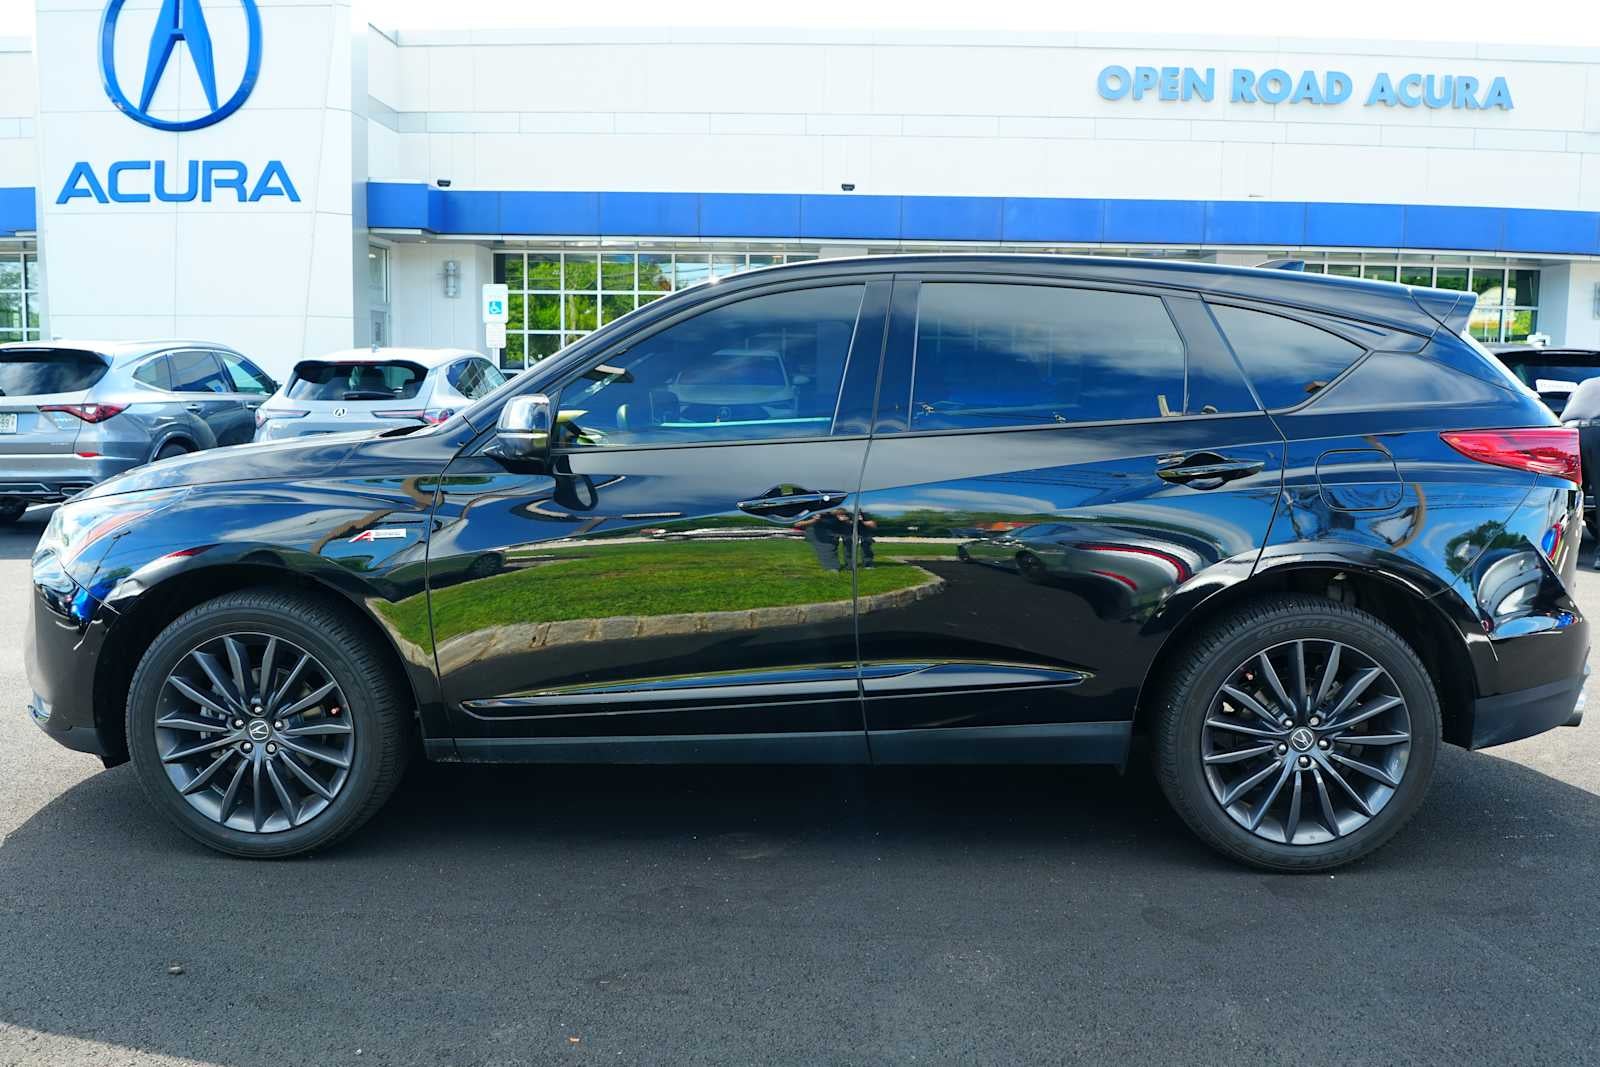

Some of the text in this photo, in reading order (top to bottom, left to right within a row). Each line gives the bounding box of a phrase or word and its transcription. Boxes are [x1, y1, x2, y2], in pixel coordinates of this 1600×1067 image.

[1097, 65, 1515, 111] OPEN ROAD ACURA
[56, 159, 302, 205] ACURA
